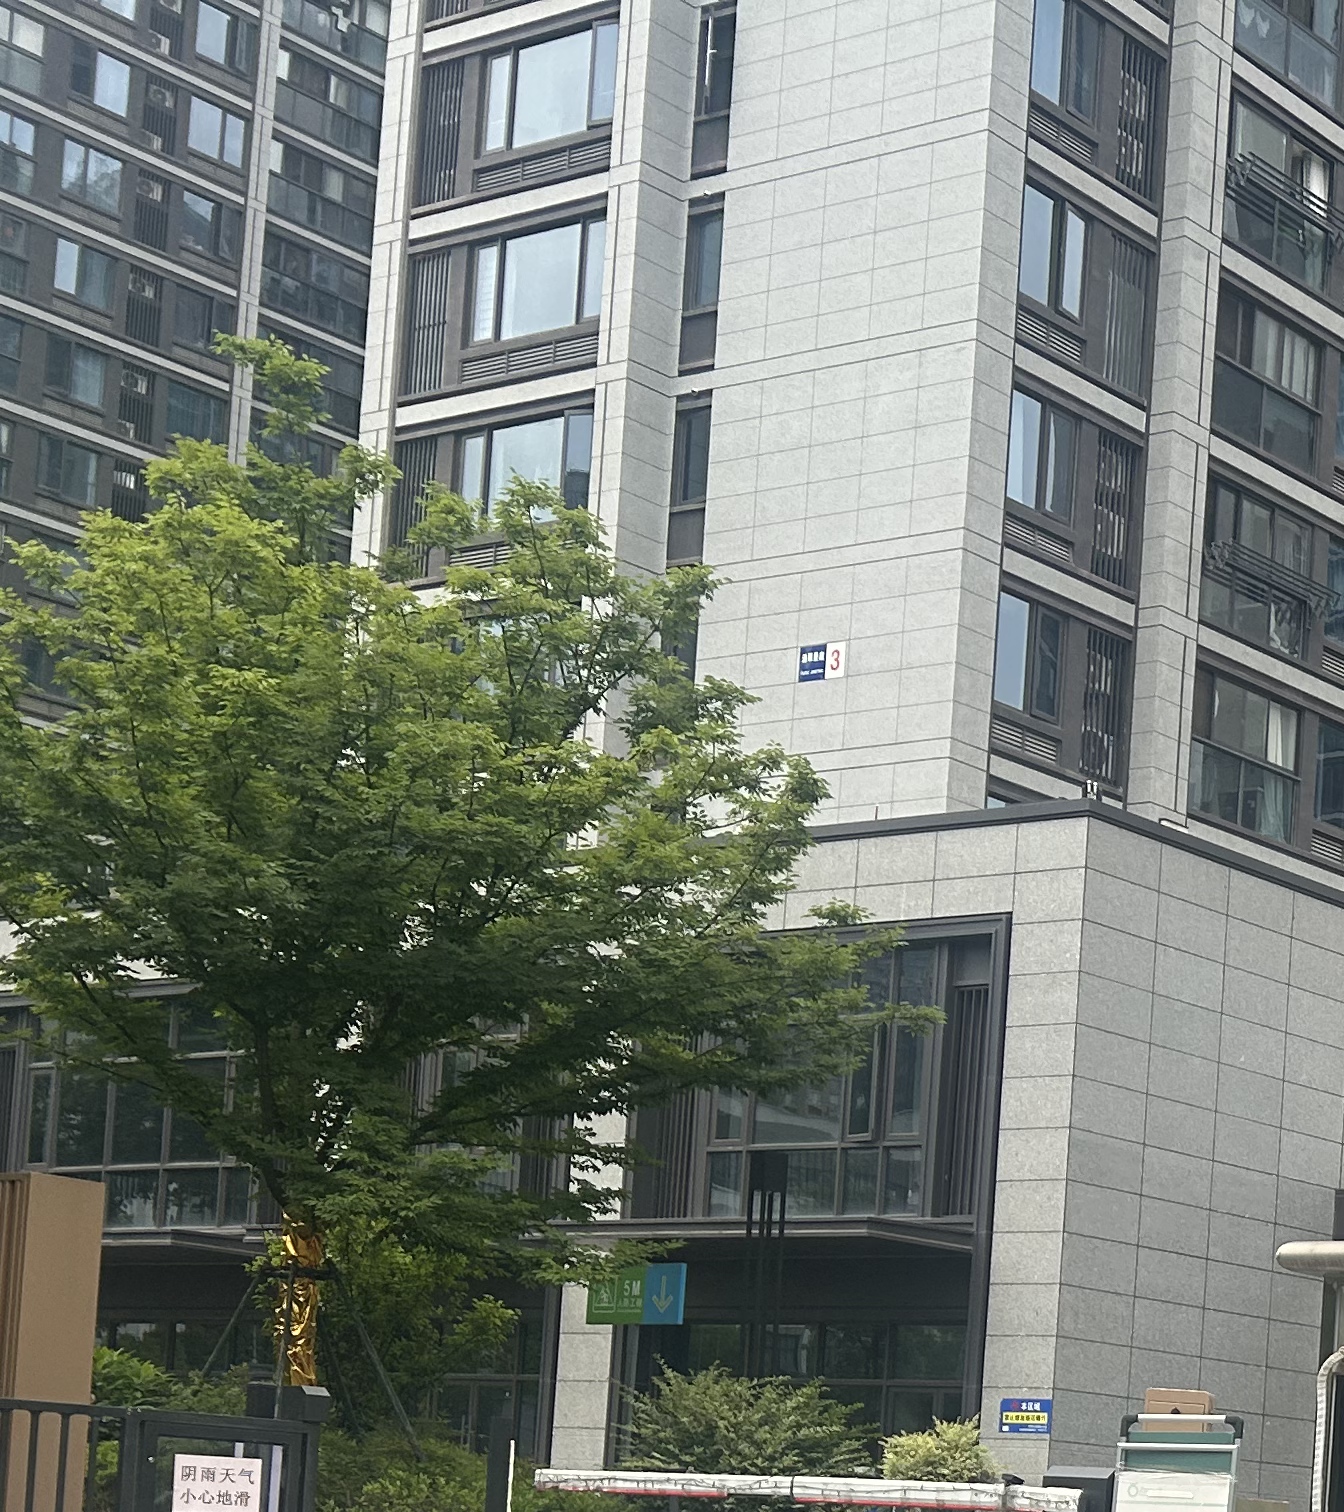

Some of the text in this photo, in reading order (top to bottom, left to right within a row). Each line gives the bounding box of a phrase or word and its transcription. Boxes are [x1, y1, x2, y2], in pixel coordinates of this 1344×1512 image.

[830, 649, 840, 671] 3
[180, 1465, 255, 1484] 阴雨天气
[180, 1488, 251, 1507] 小心地滑
